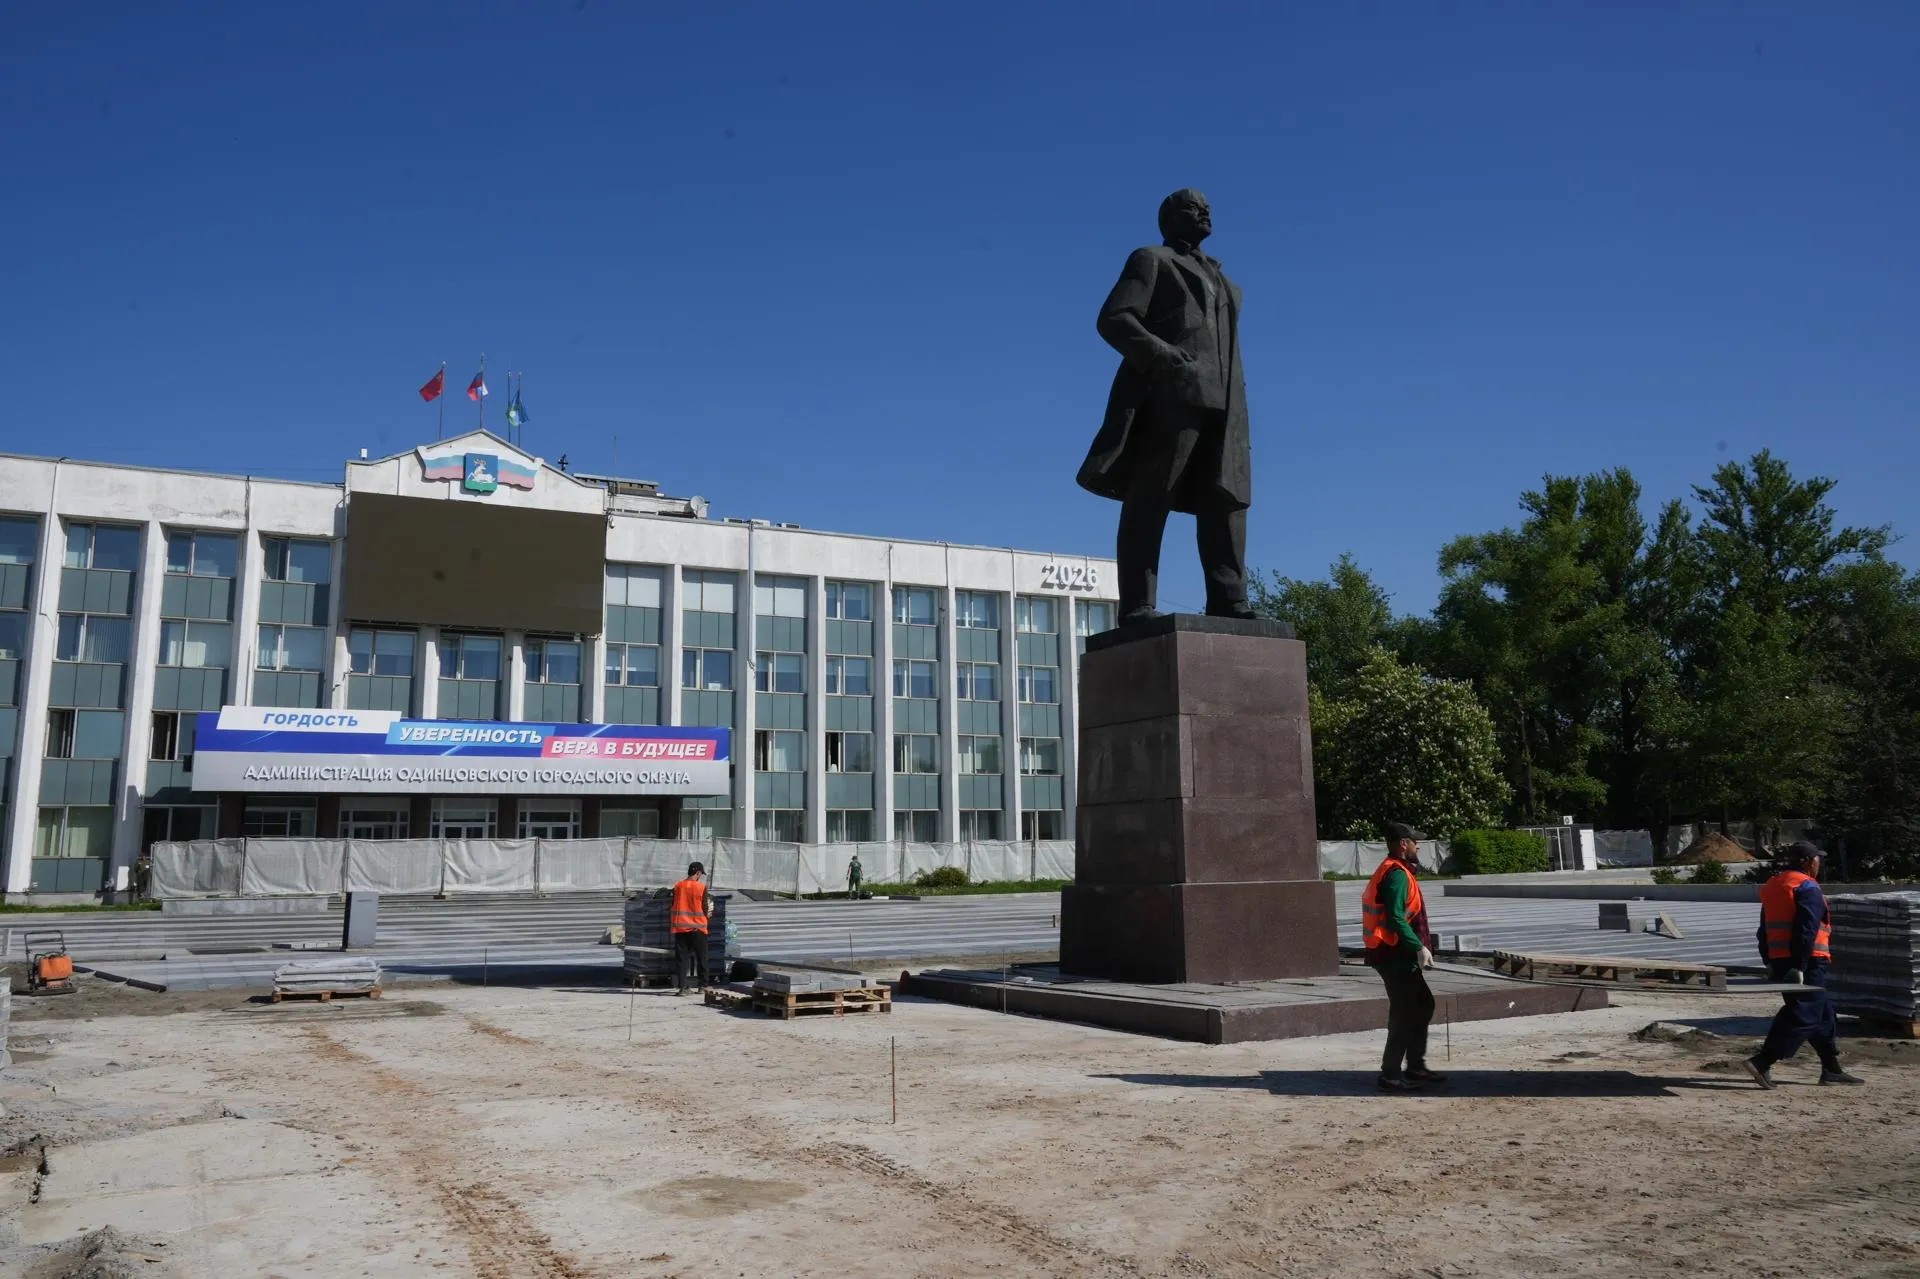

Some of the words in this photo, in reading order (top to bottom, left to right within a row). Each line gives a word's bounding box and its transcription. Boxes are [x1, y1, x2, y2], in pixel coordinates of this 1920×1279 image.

[1042, 561, 1098, 590] 2026
[263, 713, 359, 727] ГОРДОСТЬ
[399, 726, 542, 743] УВЕРЕННОСТЬ
[551, 740, 599, 755] ВЕРА
[604, 742, 617, 755] В
[621, 742, 708, 759] БУДУЩЕЕ
[244, 764, 393, 782] АДМИНИСТРАЦИЯ
[396, 767, 529, 785] ОДИНЦОВСКОГО
[534, 769, 634, 785] ГОРОДСКОГО
[638, 771, 692, 785] ОКРУГА
